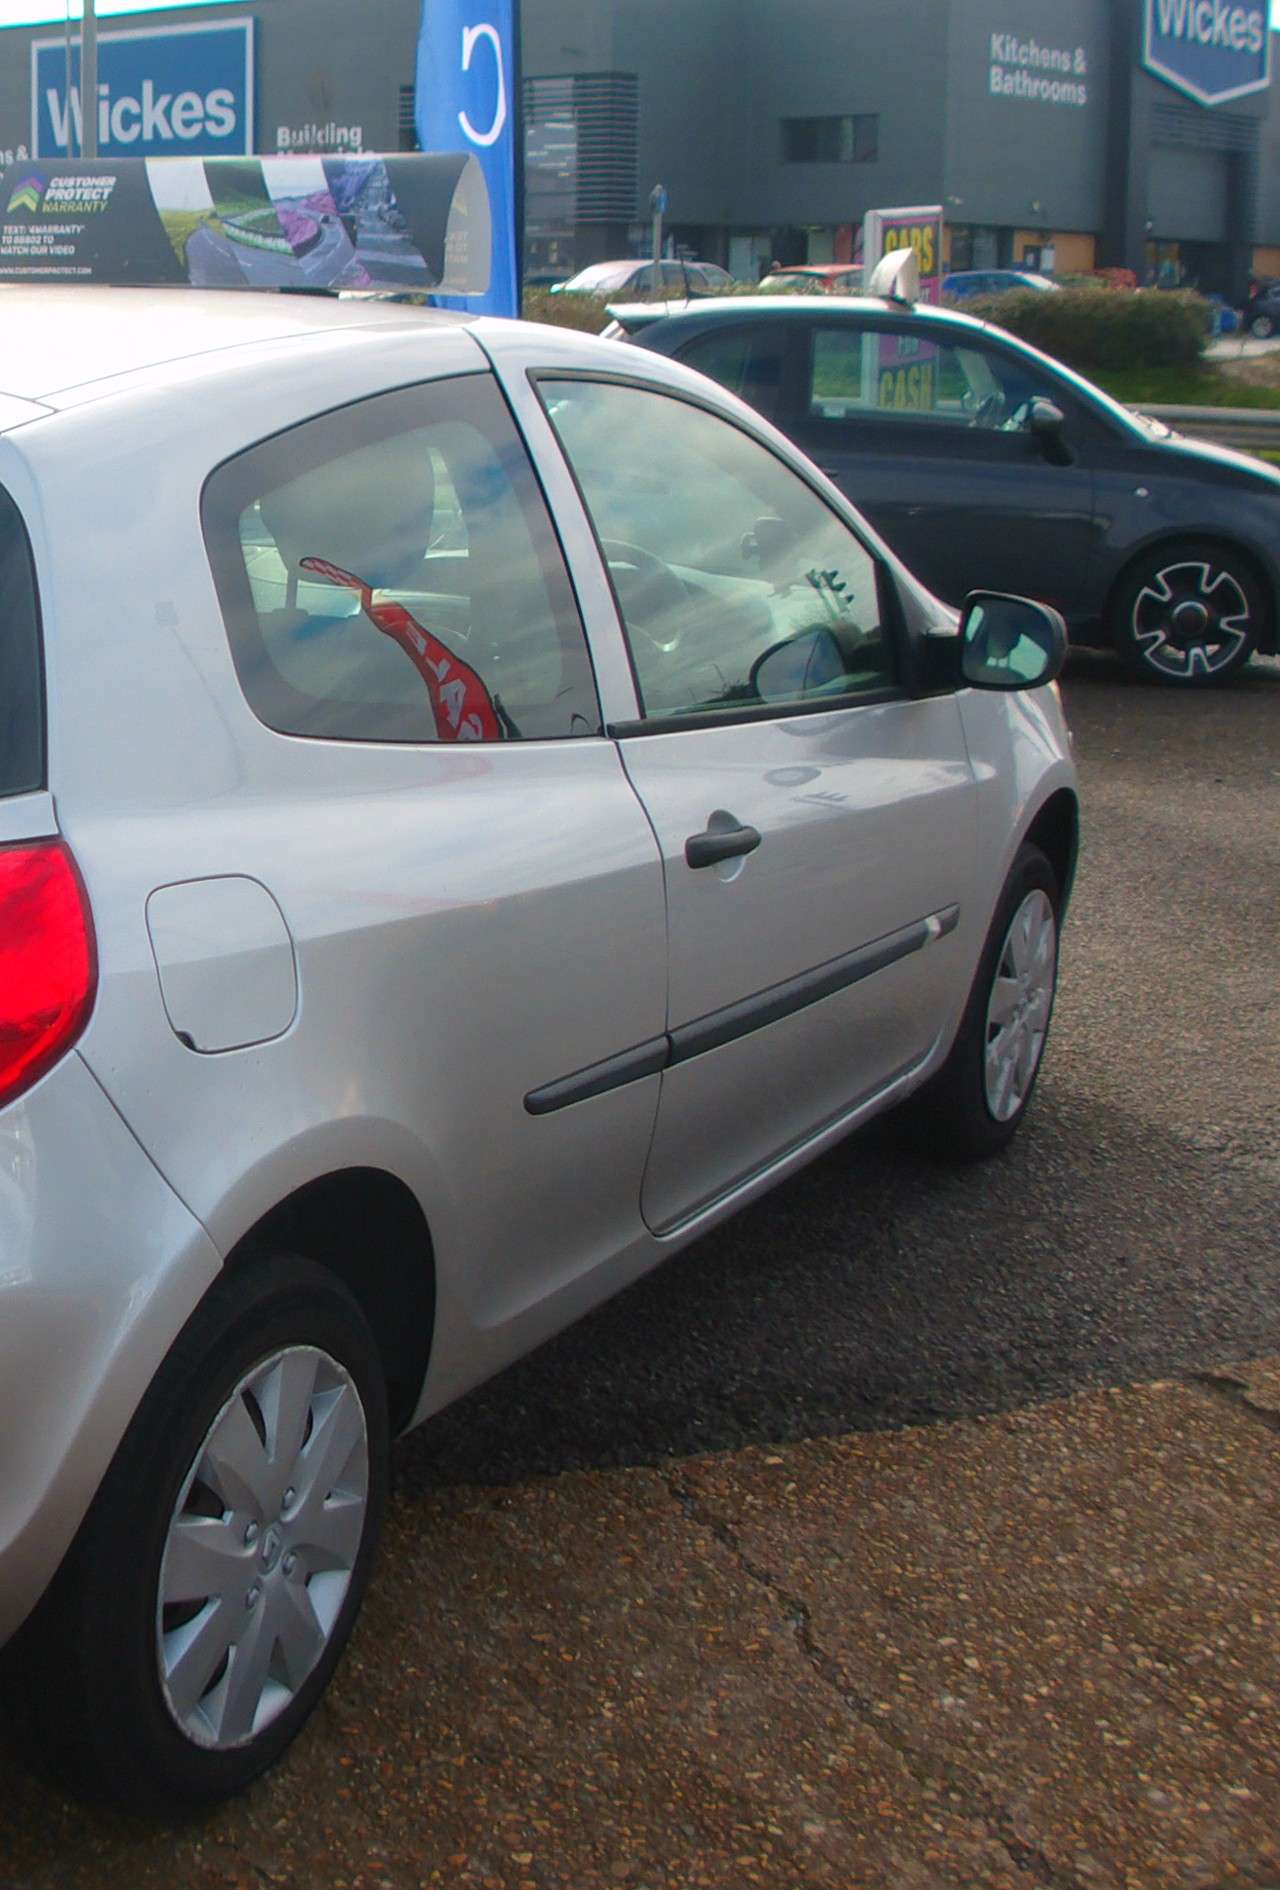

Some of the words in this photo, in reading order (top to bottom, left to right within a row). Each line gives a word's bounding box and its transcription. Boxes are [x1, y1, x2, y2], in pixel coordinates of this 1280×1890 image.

[1156, 0, 1264, 53] Wickes
[989, 33, 1072, 73] Kitchens
[1073, 47, 1087, 76] &
[988, 65, 1087, 106] Bathrooms
[46, 79, 237, 148] Wickes
[277, 122, 363, 147] Building
[16, 144, 28, 161] &
[49, 175, 117, 188] CUSTOMER
[44, 188, 114, 201] PROTECT
[41, 201, 109, 214] WARRANTY
[0, 246, 28, 256] WATCH
[30, 246, 48, 255] OUR
[49, 245, 76, 255] VIDEO
[879, 361, 934, 411] CASH
